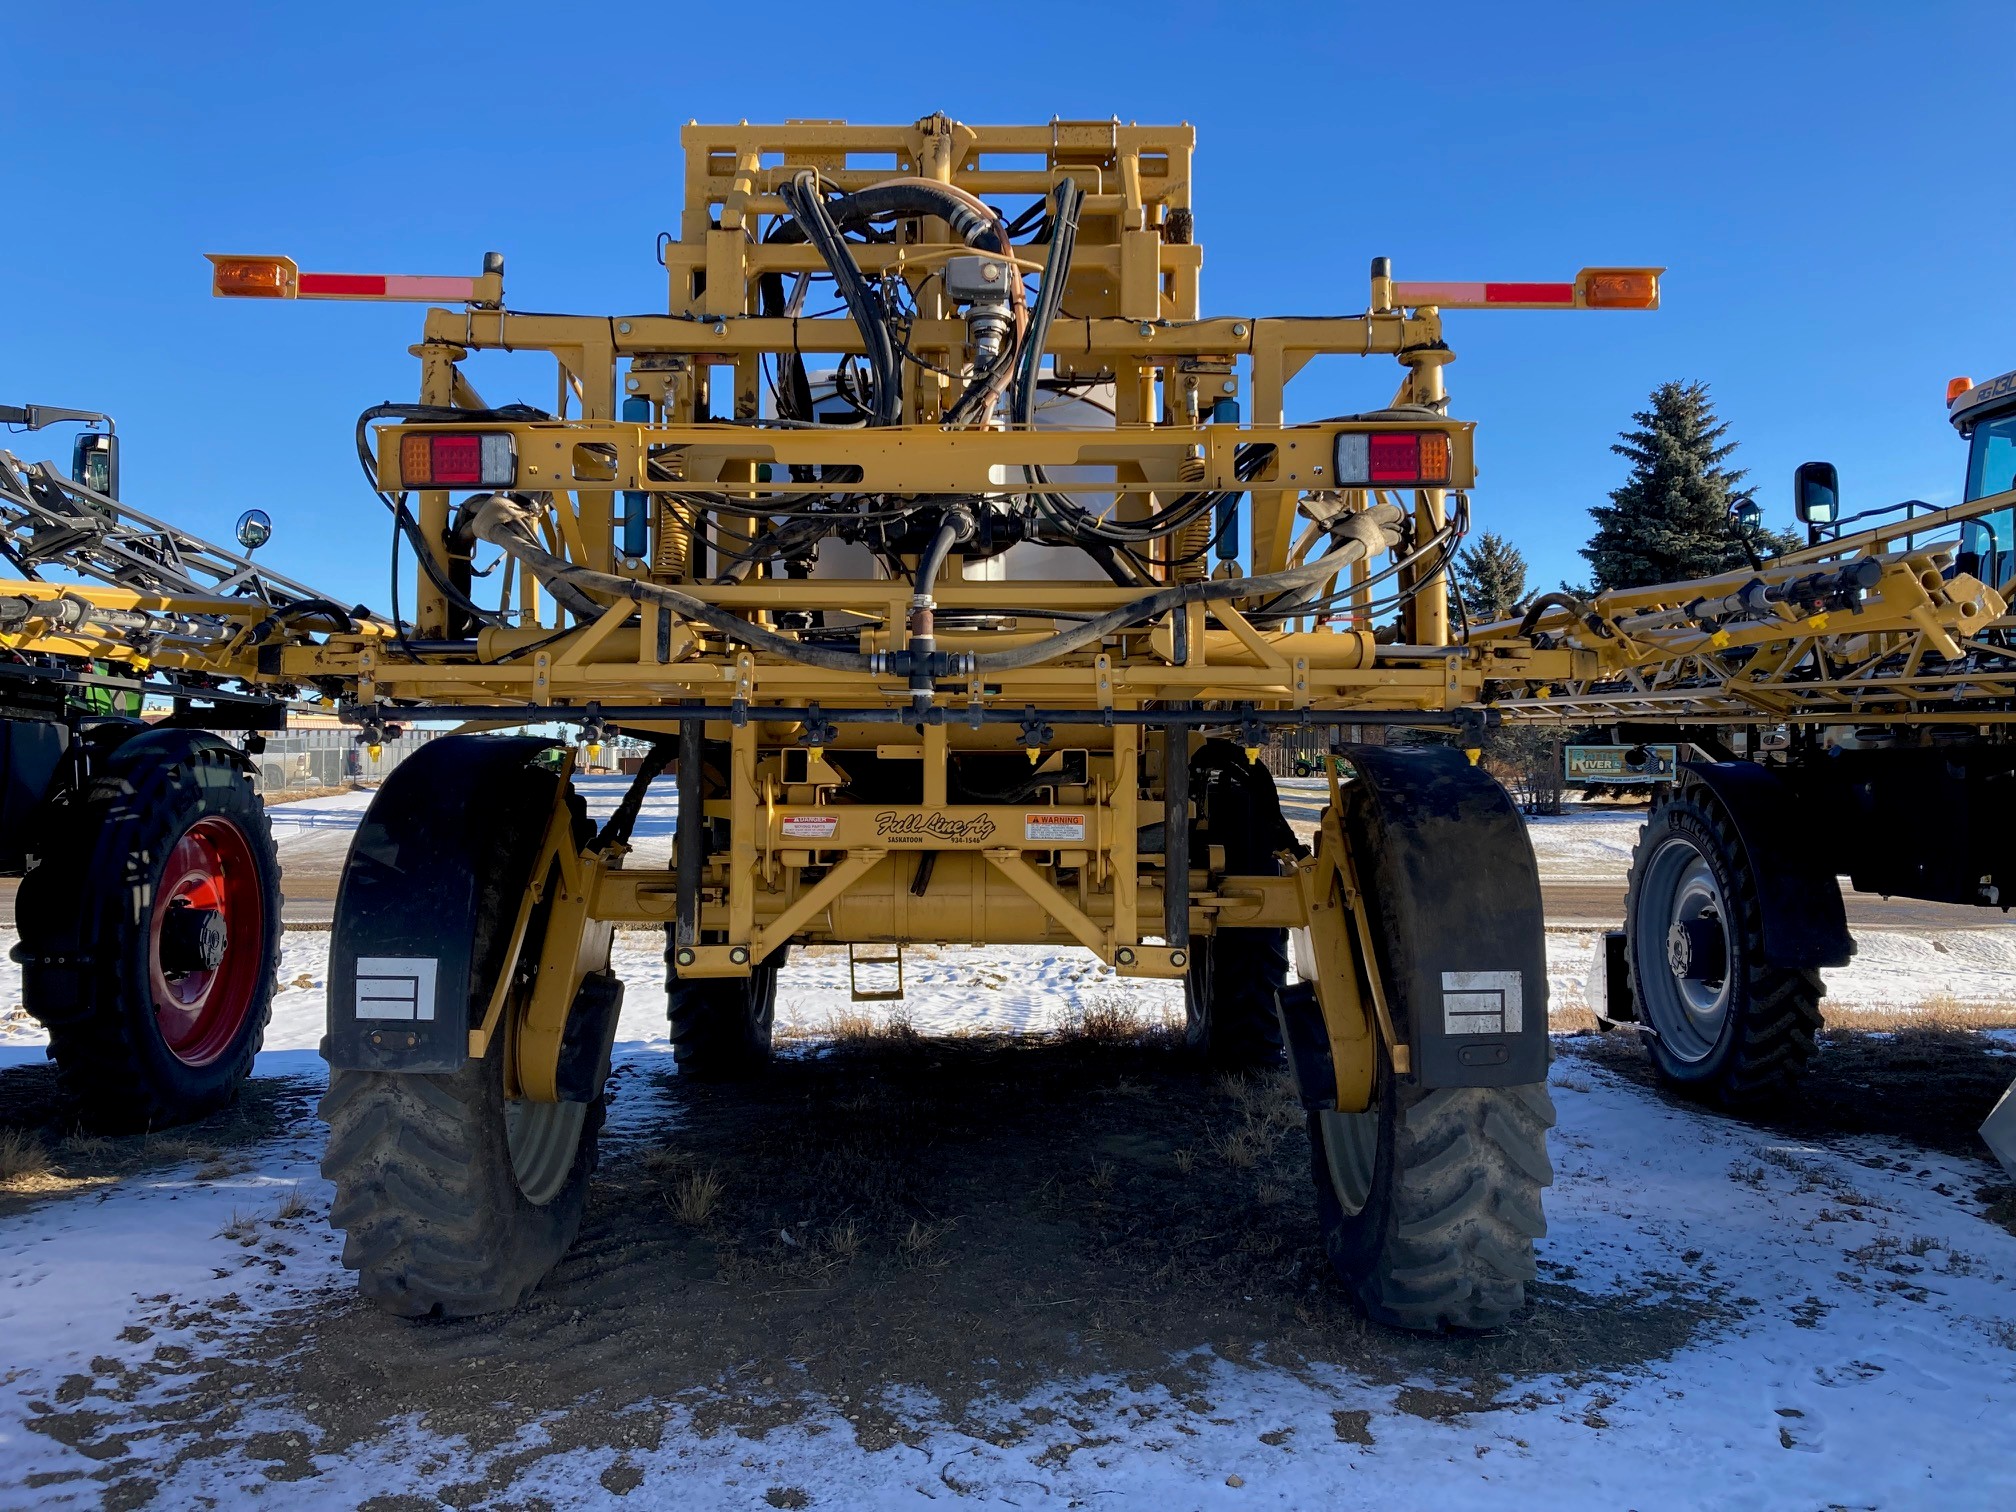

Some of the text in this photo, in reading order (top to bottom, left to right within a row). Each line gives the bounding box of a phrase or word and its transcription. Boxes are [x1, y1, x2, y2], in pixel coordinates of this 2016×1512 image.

[1571, 750, 1619, 760] BATTLE
[1571, 758, 1612, 773] RIVER
[875, 811, 995, 840] Full Line Ag
[1041, 816, 1079, 824] WARNING
